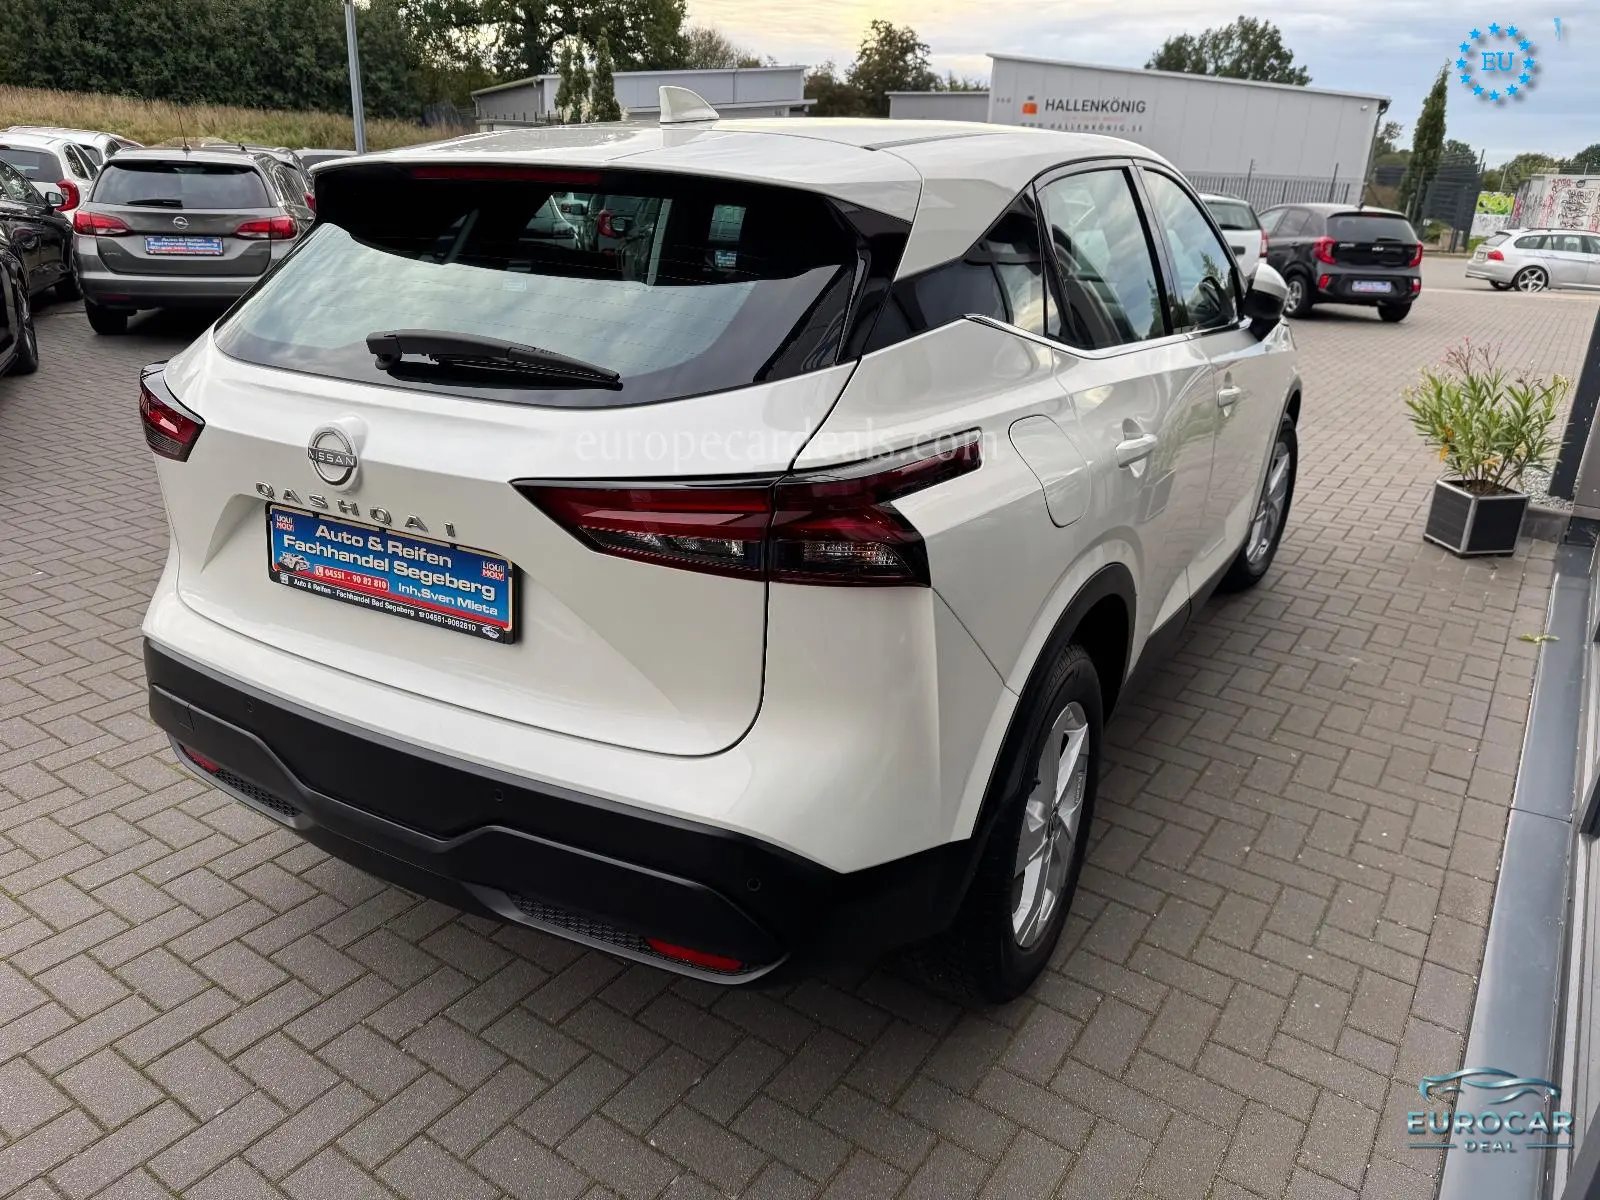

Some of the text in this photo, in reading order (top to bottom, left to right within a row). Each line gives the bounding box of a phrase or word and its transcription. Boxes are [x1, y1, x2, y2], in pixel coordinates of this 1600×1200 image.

[1045, 96, 1146, 113] HALLENKÖNIG
[308, 448, 355, 466] NISSAN
[255, 481, 455, 537] QASHQAI
[315, 525, 452, 568] Auto & Reifen
[283, 535, 496, 600] Fachhandel Segeberg
[324, 569, 345, 580] 04551
[352, 575, 361, 584] 90
[362, 577, 372, 586] 82
[374, 579, 387, 589] 810
[293, 579, 307, 588] Auto
[336, 590, 370, 604] Fachhandel
[371, 599, 384, 608] Bad
